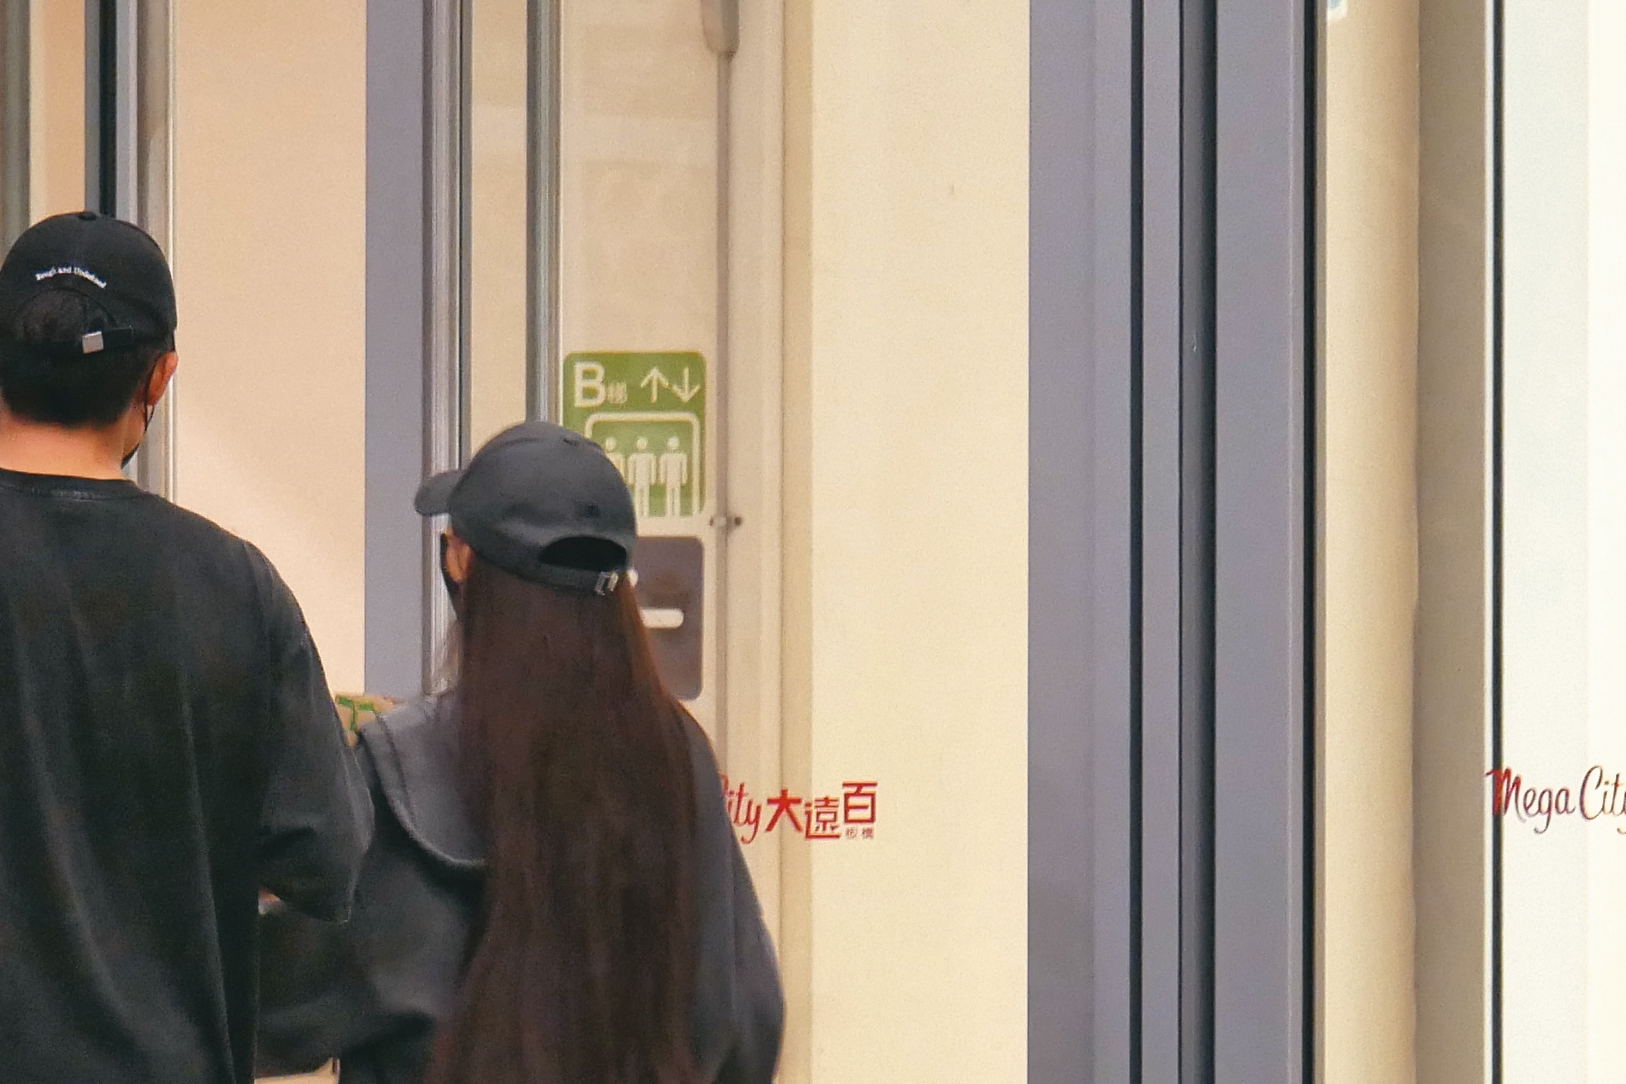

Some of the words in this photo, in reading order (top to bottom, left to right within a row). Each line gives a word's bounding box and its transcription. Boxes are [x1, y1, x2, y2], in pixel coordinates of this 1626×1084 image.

[720, 773, 762, 845] ity
[764, 781, 878, 840] 大遠百
[1484, 766, 1576, 834] Mega
